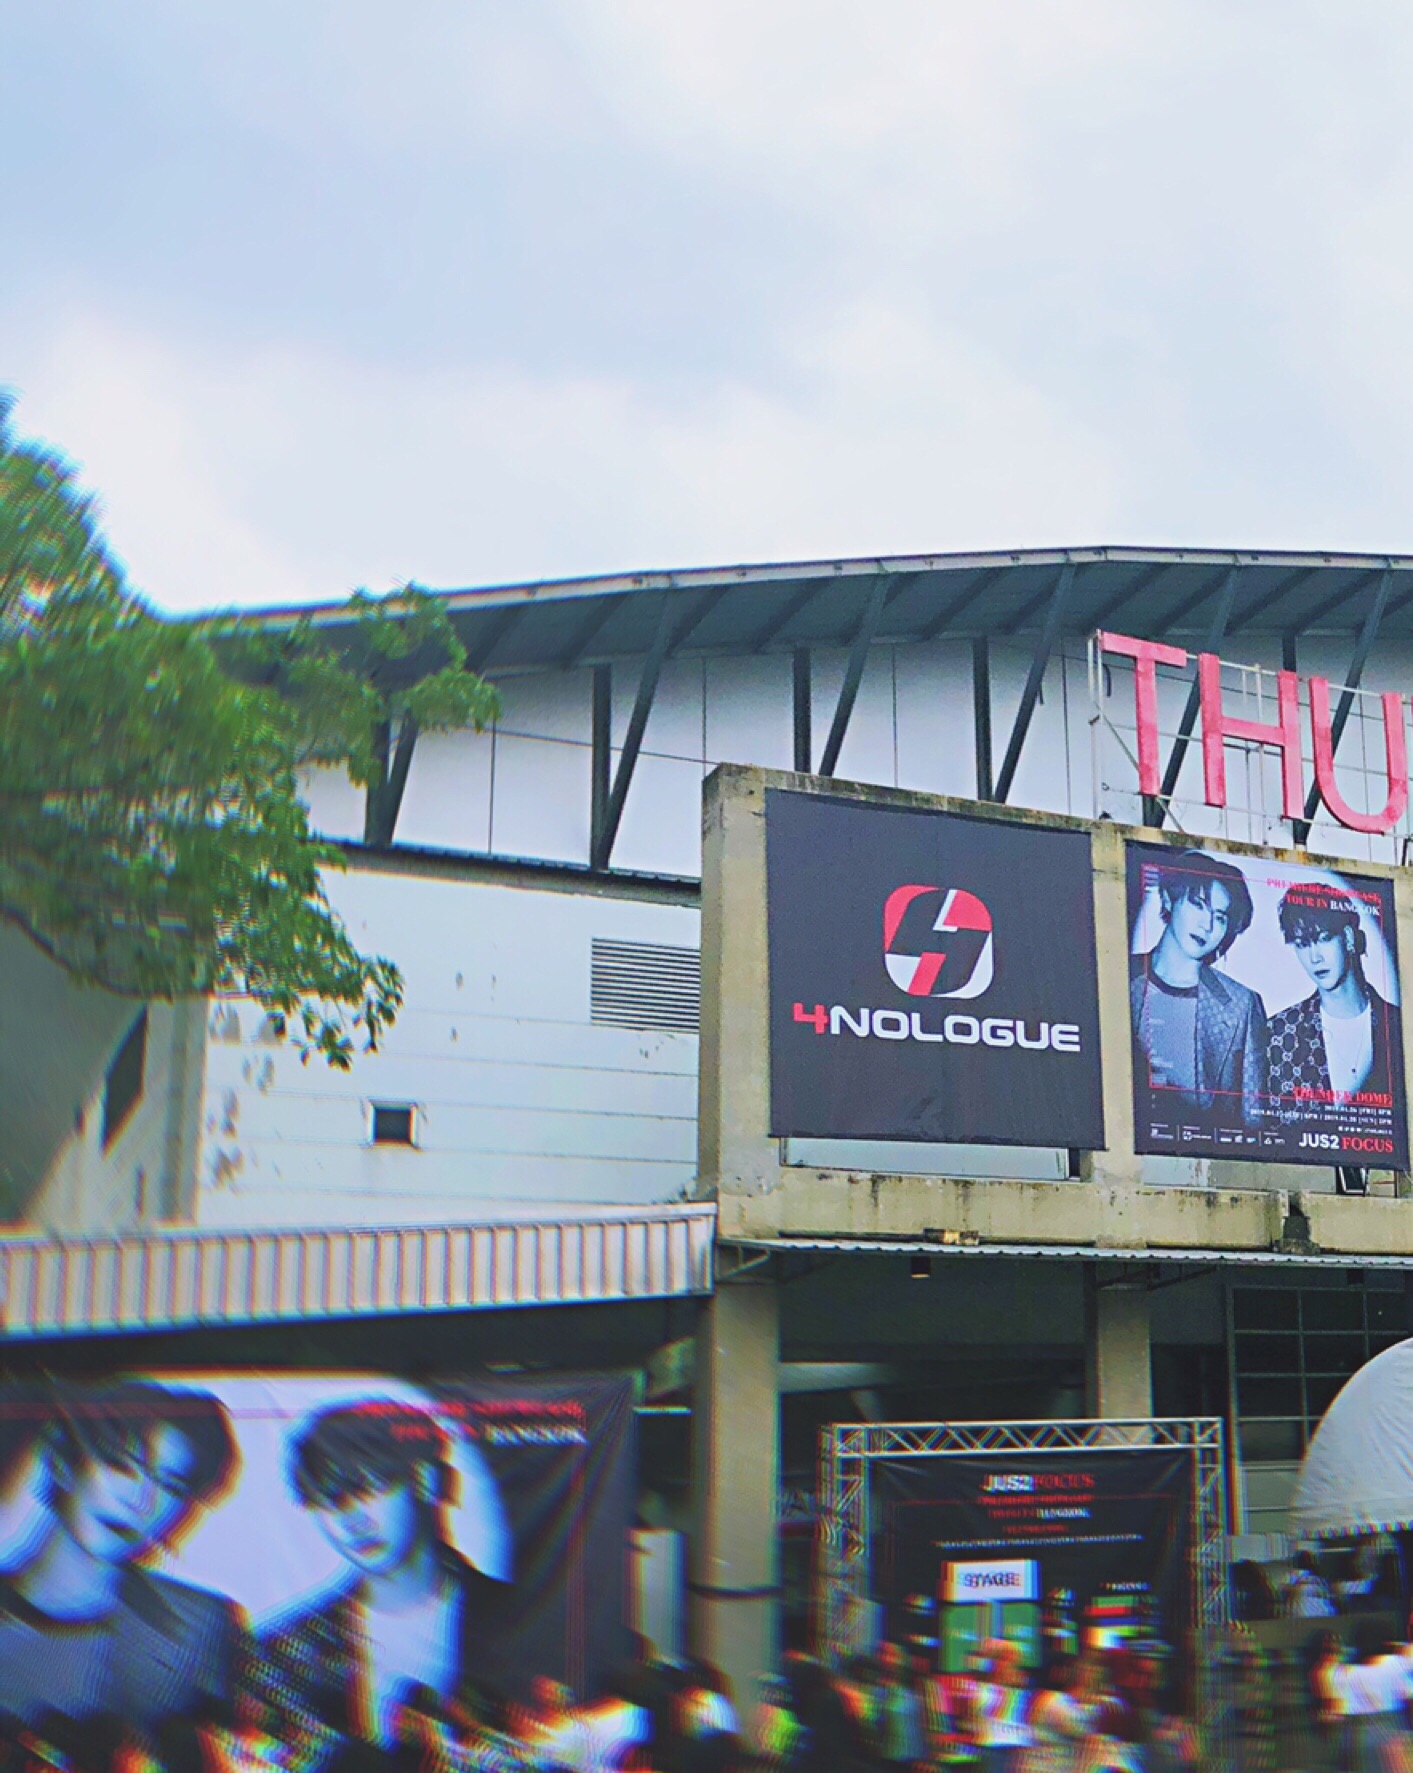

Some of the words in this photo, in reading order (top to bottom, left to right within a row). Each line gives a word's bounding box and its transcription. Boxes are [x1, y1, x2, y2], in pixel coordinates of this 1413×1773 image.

[1285, 894, 1315, 907] TOUR
[1316, 898, 1328, 908] IN
[1330, 900, 1380, 916] BANGOK
[793, 1002, 1081, 1052] 4NOLOGUE
[1293, 1086, 1352, 1103] THUNDER
[1356, 1091, 1391, 1107] DOME
[1299, 1132, 1340, 1150] JUS2
[1341, 1137, 1393, 1153] FOCUS
